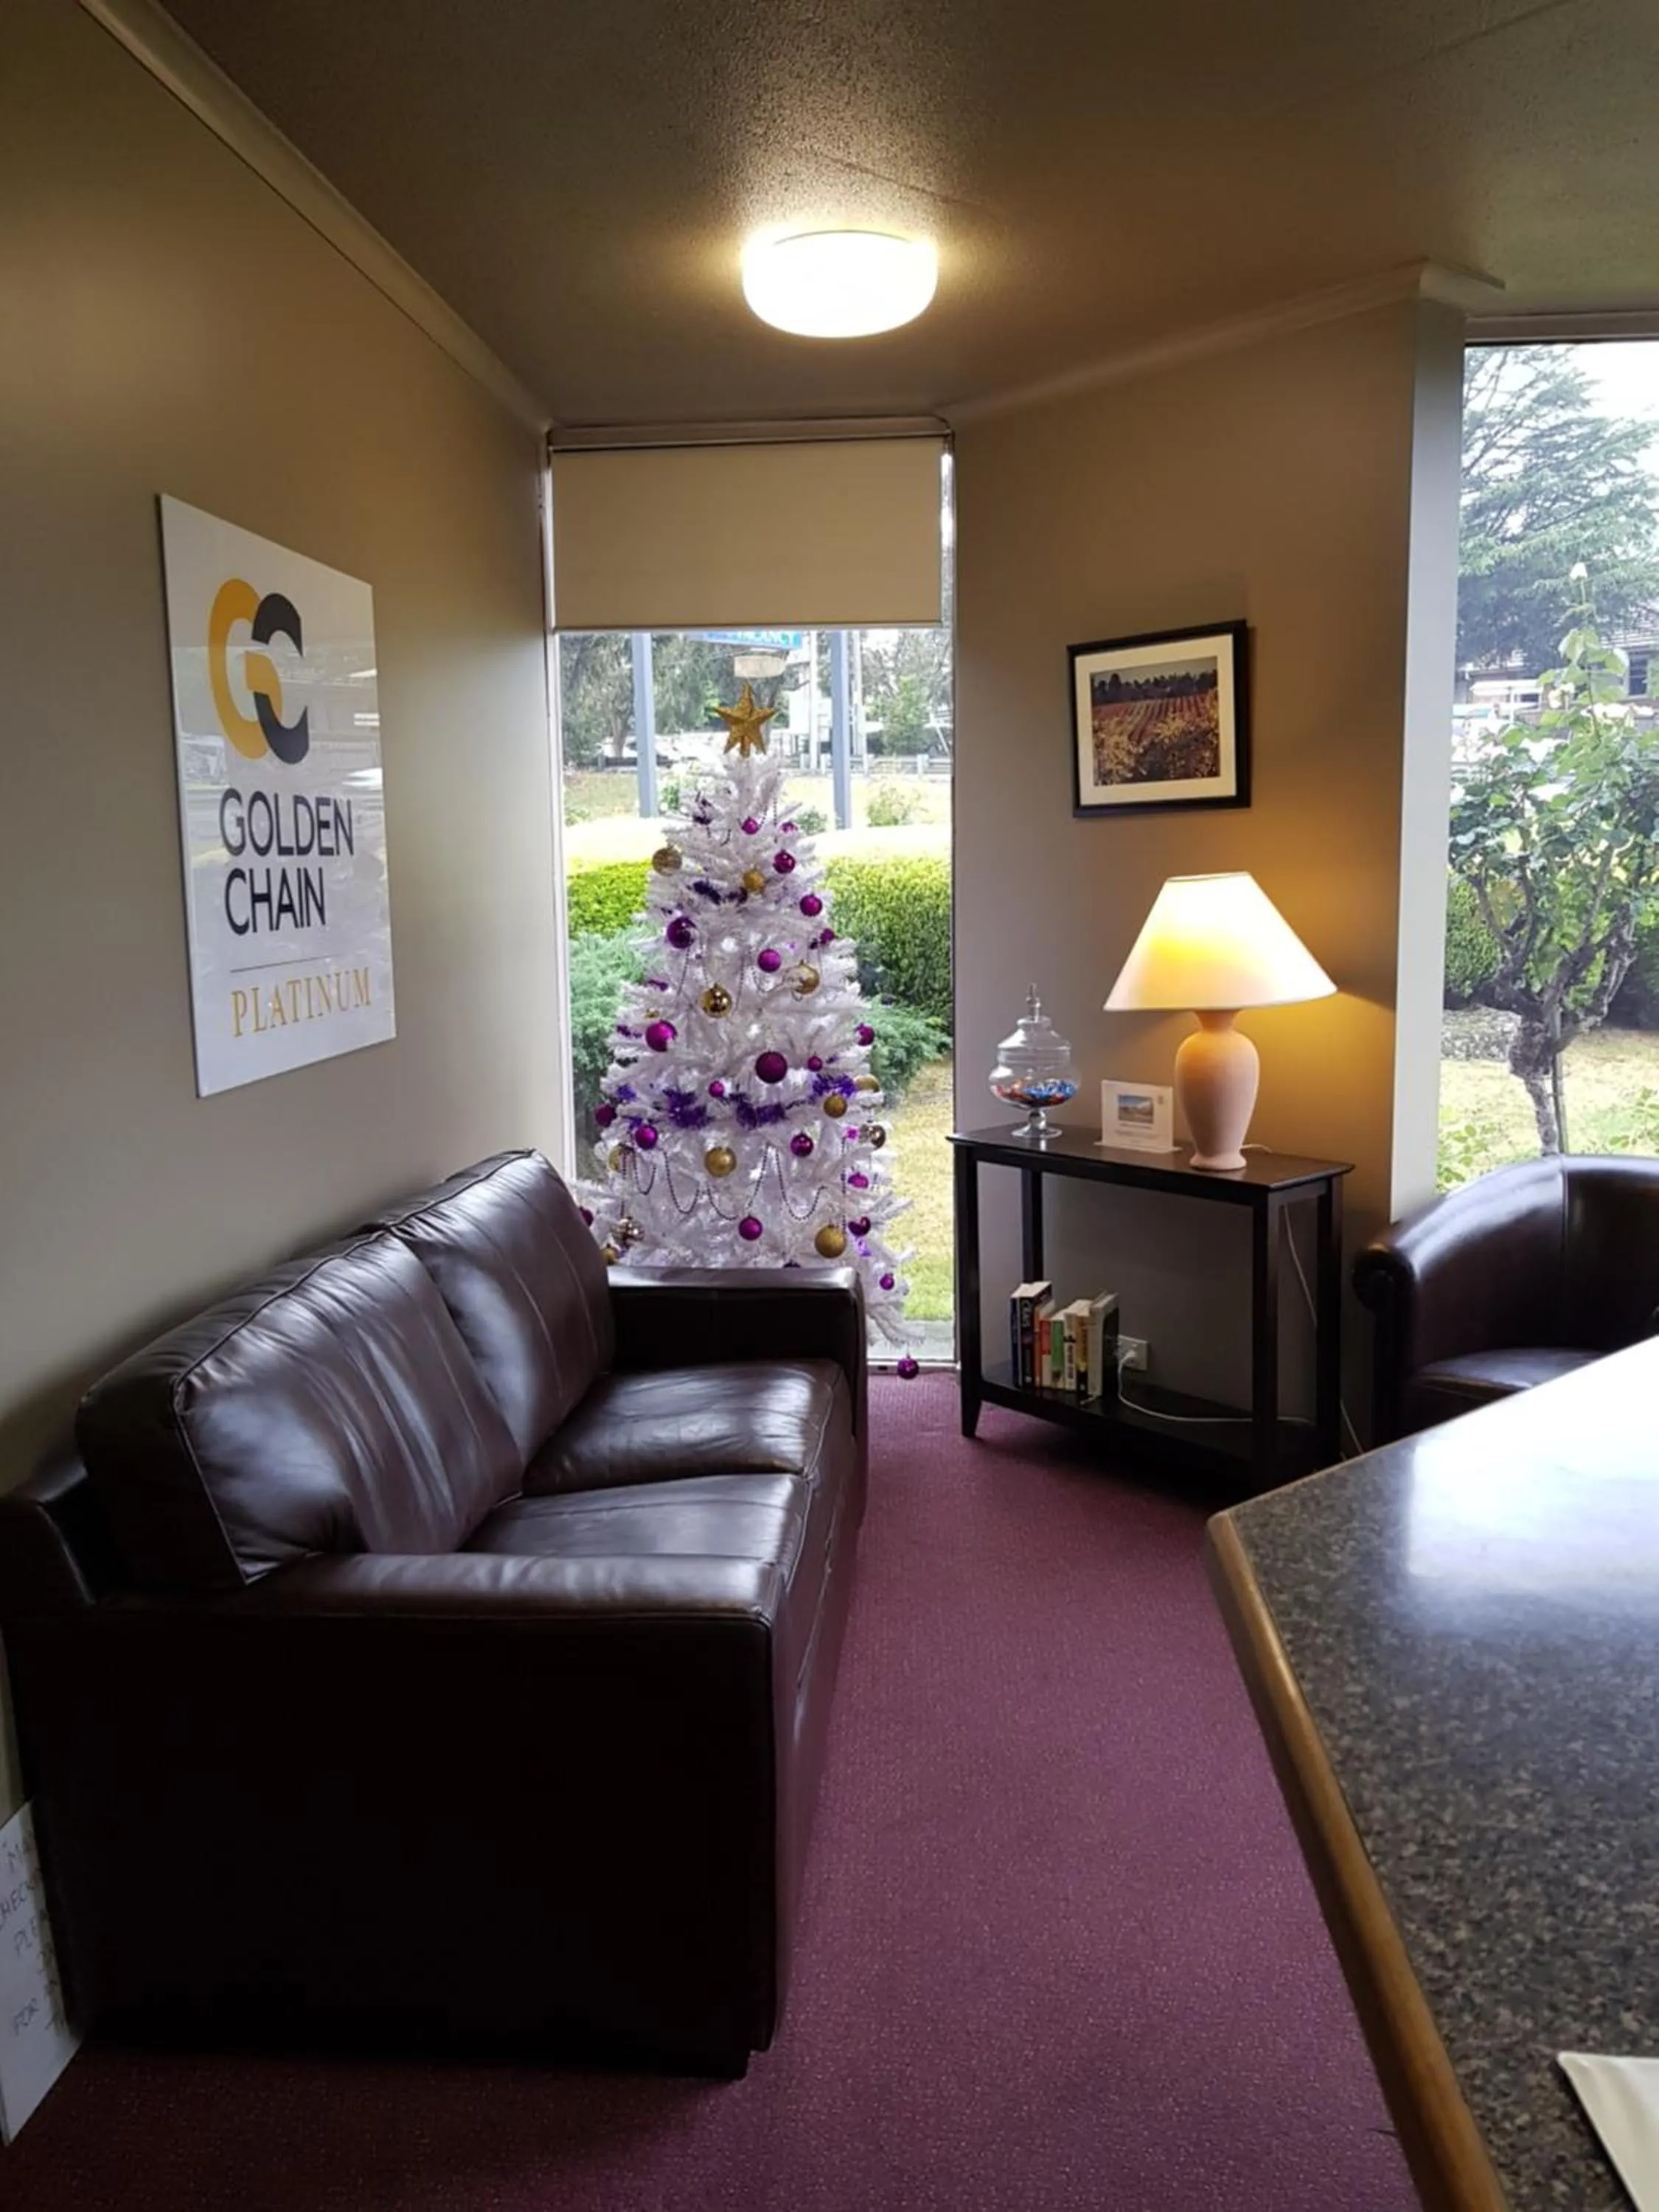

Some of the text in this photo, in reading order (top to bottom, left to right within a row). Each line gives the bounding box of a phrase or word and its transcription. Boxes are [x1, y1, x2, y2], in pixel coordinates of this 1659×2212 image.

[220, 787, 354, 857] GOLDEN
[224, 868, 327, 936] CHAIN
[231, 967, 372, 1037] PLATINUM
